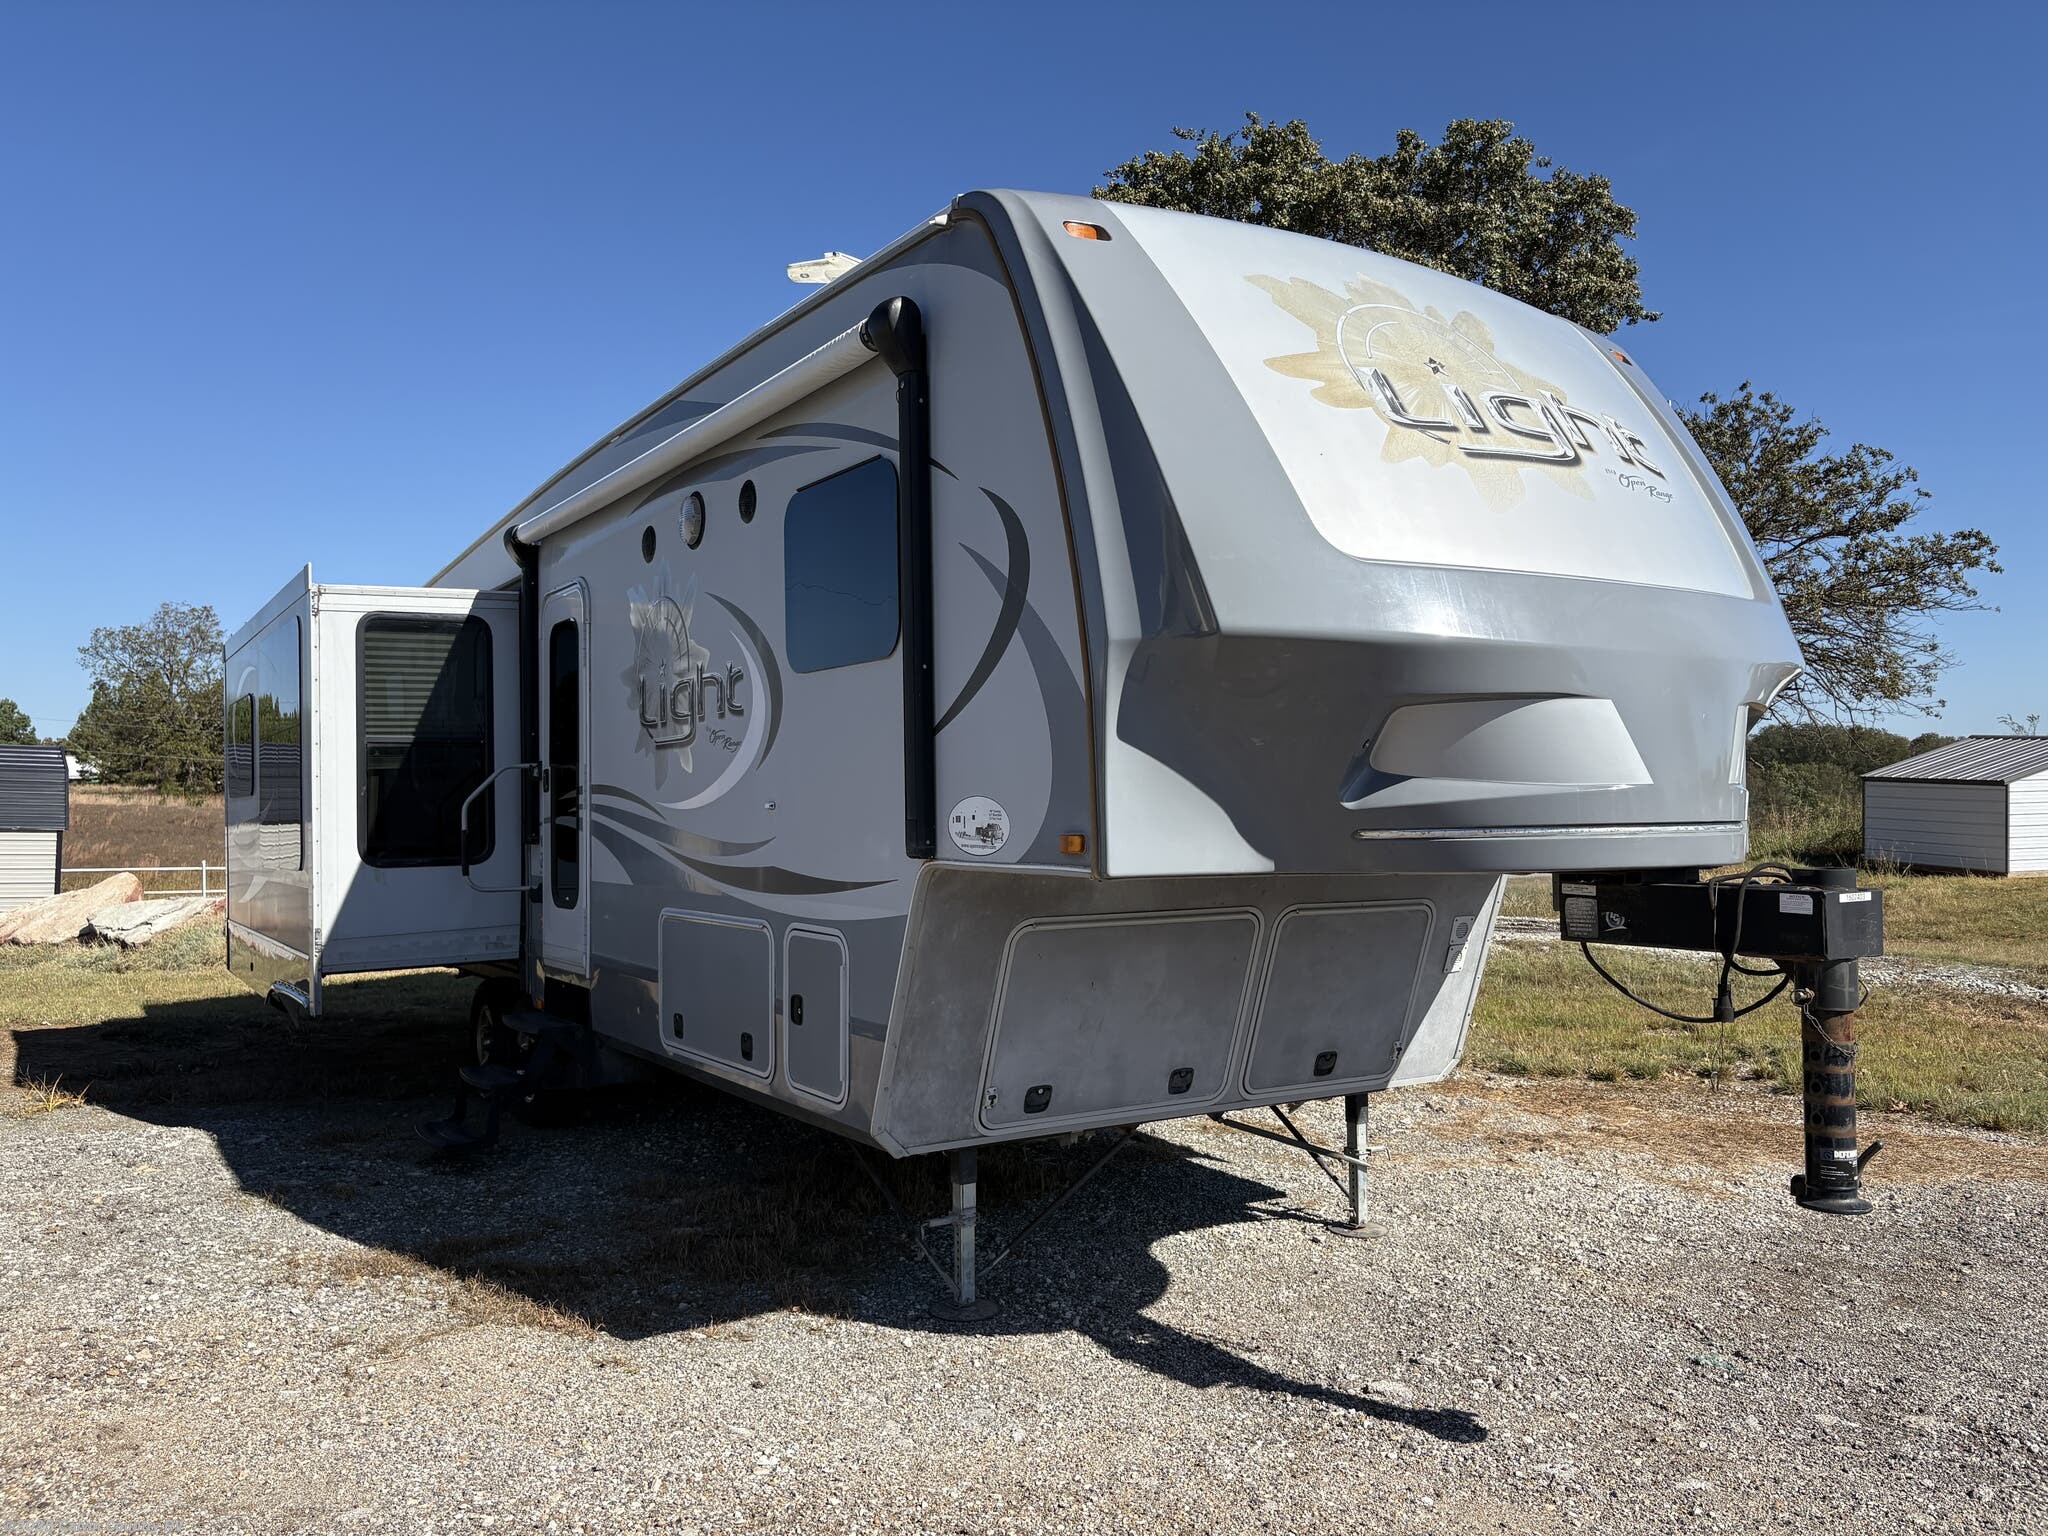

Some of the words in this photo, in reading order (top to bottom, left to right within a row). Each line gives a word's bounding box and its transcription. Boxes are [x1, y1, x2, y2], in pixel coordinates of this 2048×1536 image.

[1357, 357, 1667, 481] Light
[1618, 473, 1646, 491] Open
[1644, 486, 1673, 503] Range
[639, 658, 744, 749] Light
